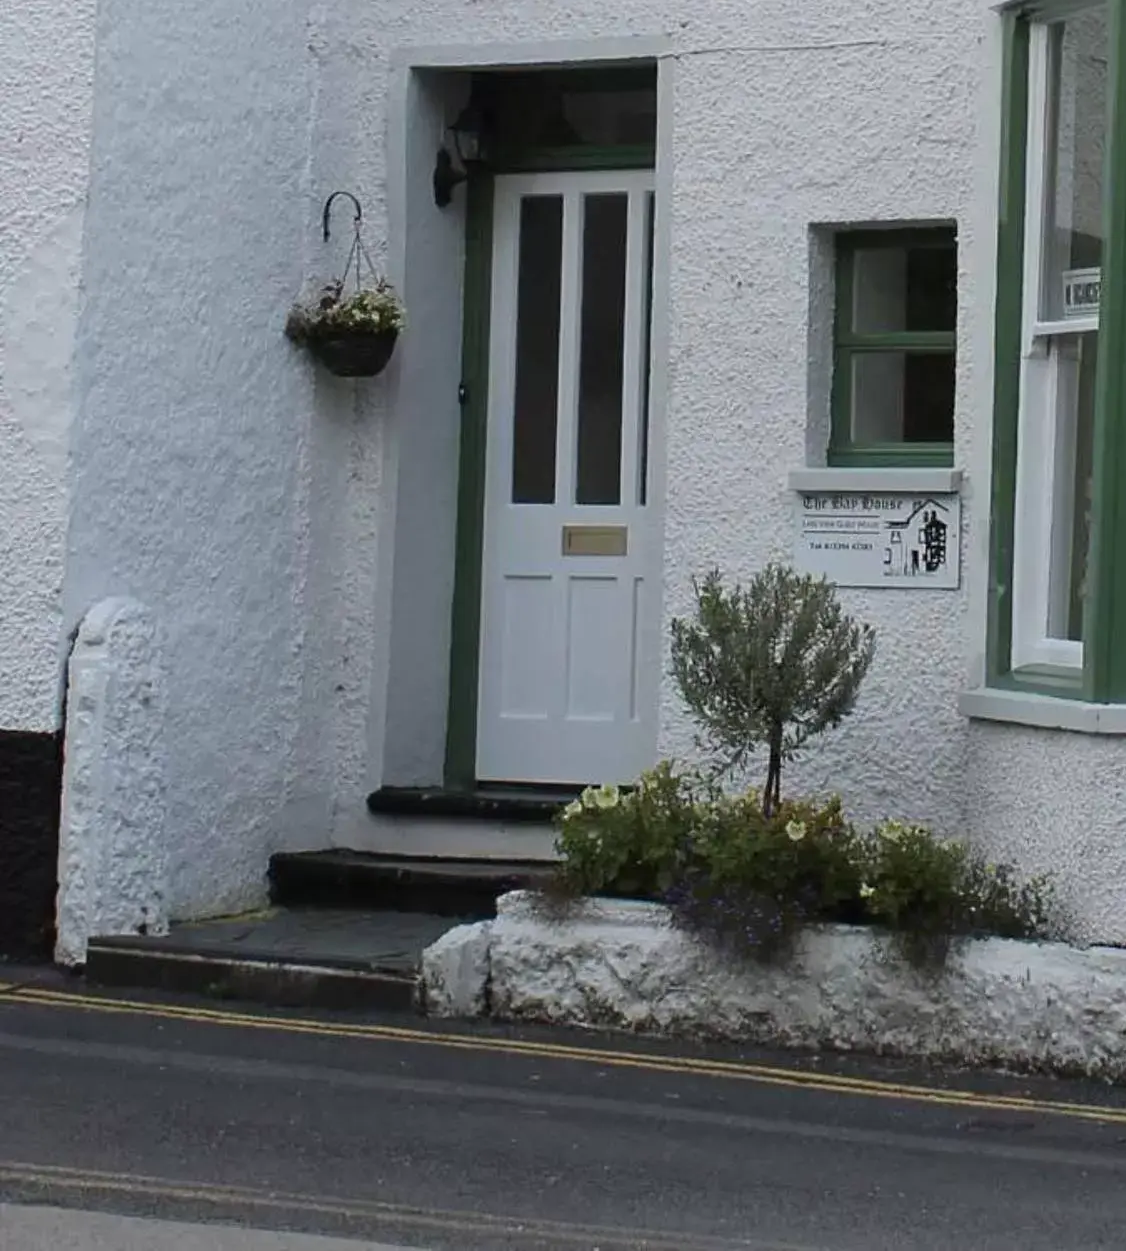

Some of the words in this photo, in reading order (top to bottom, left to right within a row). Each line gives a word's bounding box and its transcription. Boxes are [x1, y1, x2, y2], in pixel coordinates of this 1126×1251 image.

[803, 495, 827, 510] The
[831, 493, 859, 511] Bay
[861, 495, 902, 512] House
